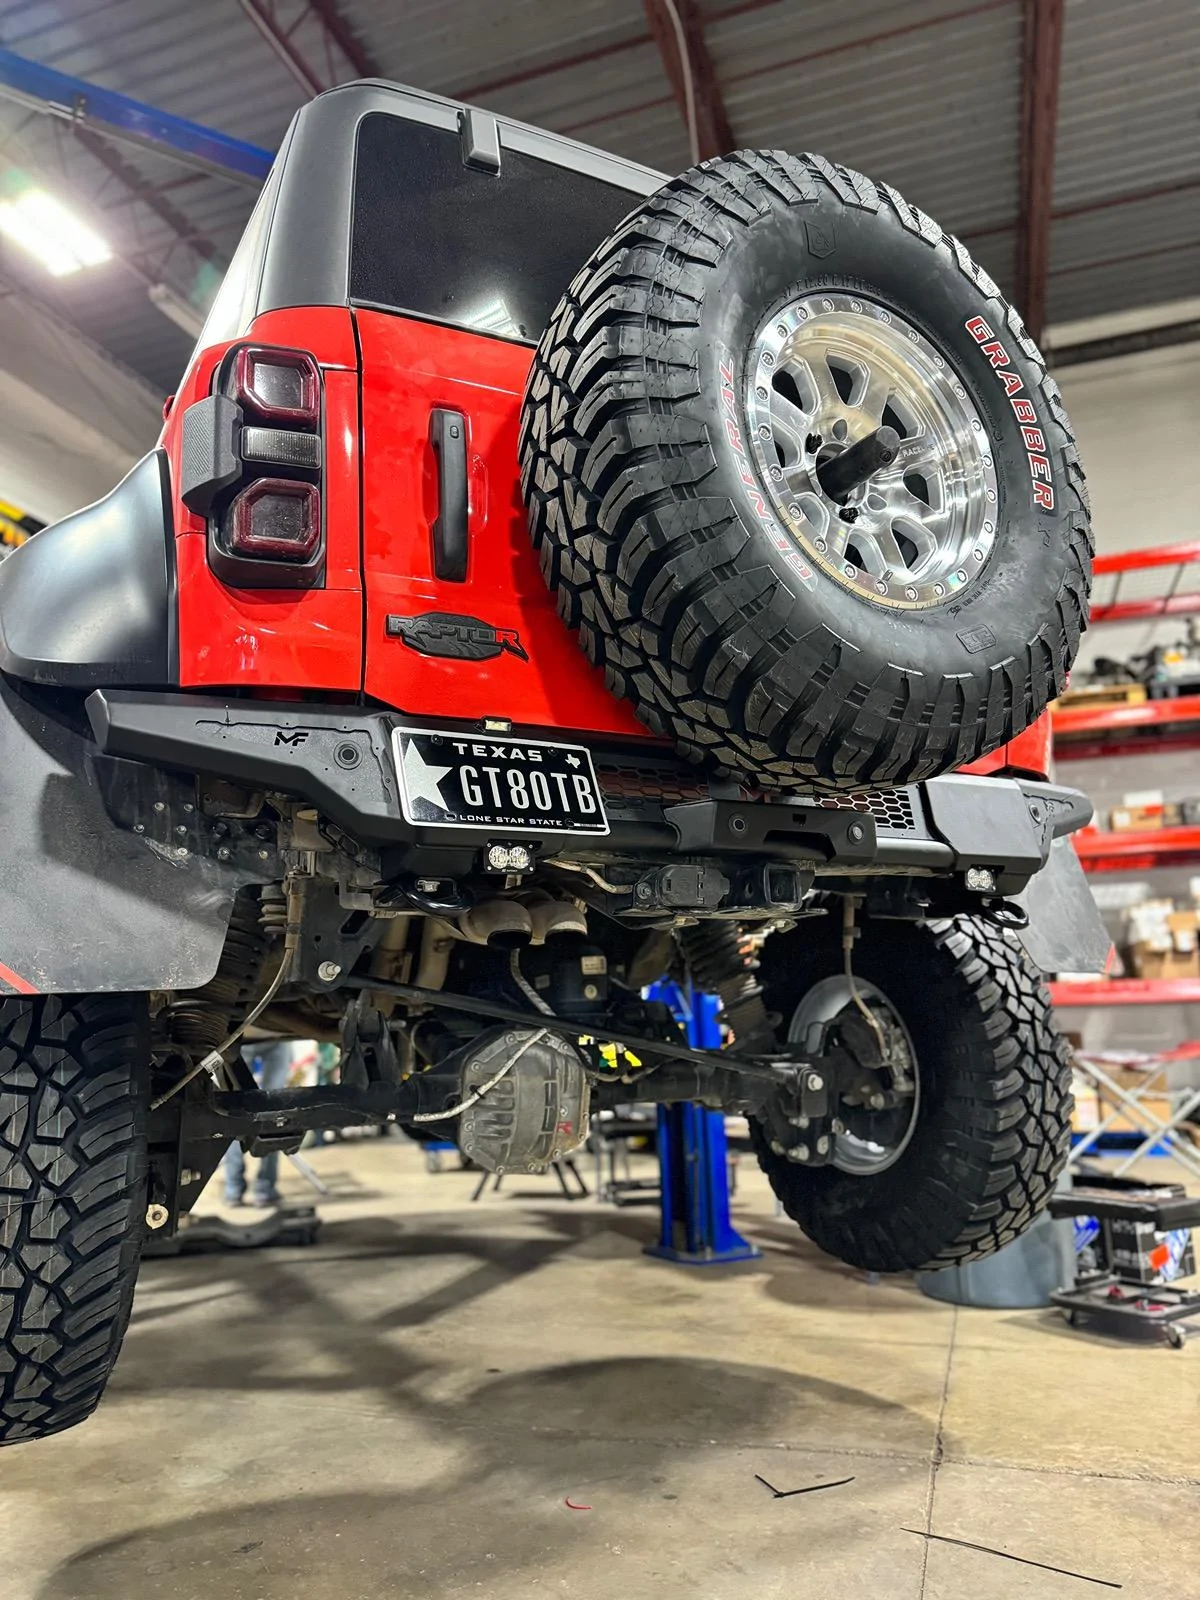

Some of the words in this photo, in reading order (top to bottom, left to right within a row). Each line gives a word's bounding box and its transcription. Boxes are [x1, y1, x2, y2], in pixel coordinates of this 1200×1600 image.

[965, 315, 1056, 510] GRABBER
[719, 357, 814, 581] GENERAL
[386, 614, 529, 662] RAPTOR
[452, 742, 543, 762] TEXAS
[459, 765, 597, 814] GT80TB
[459, 814, 492, 823] LONE
[496, 816, 525, 825] STAR
[529, 818, 563, 827] STATE
